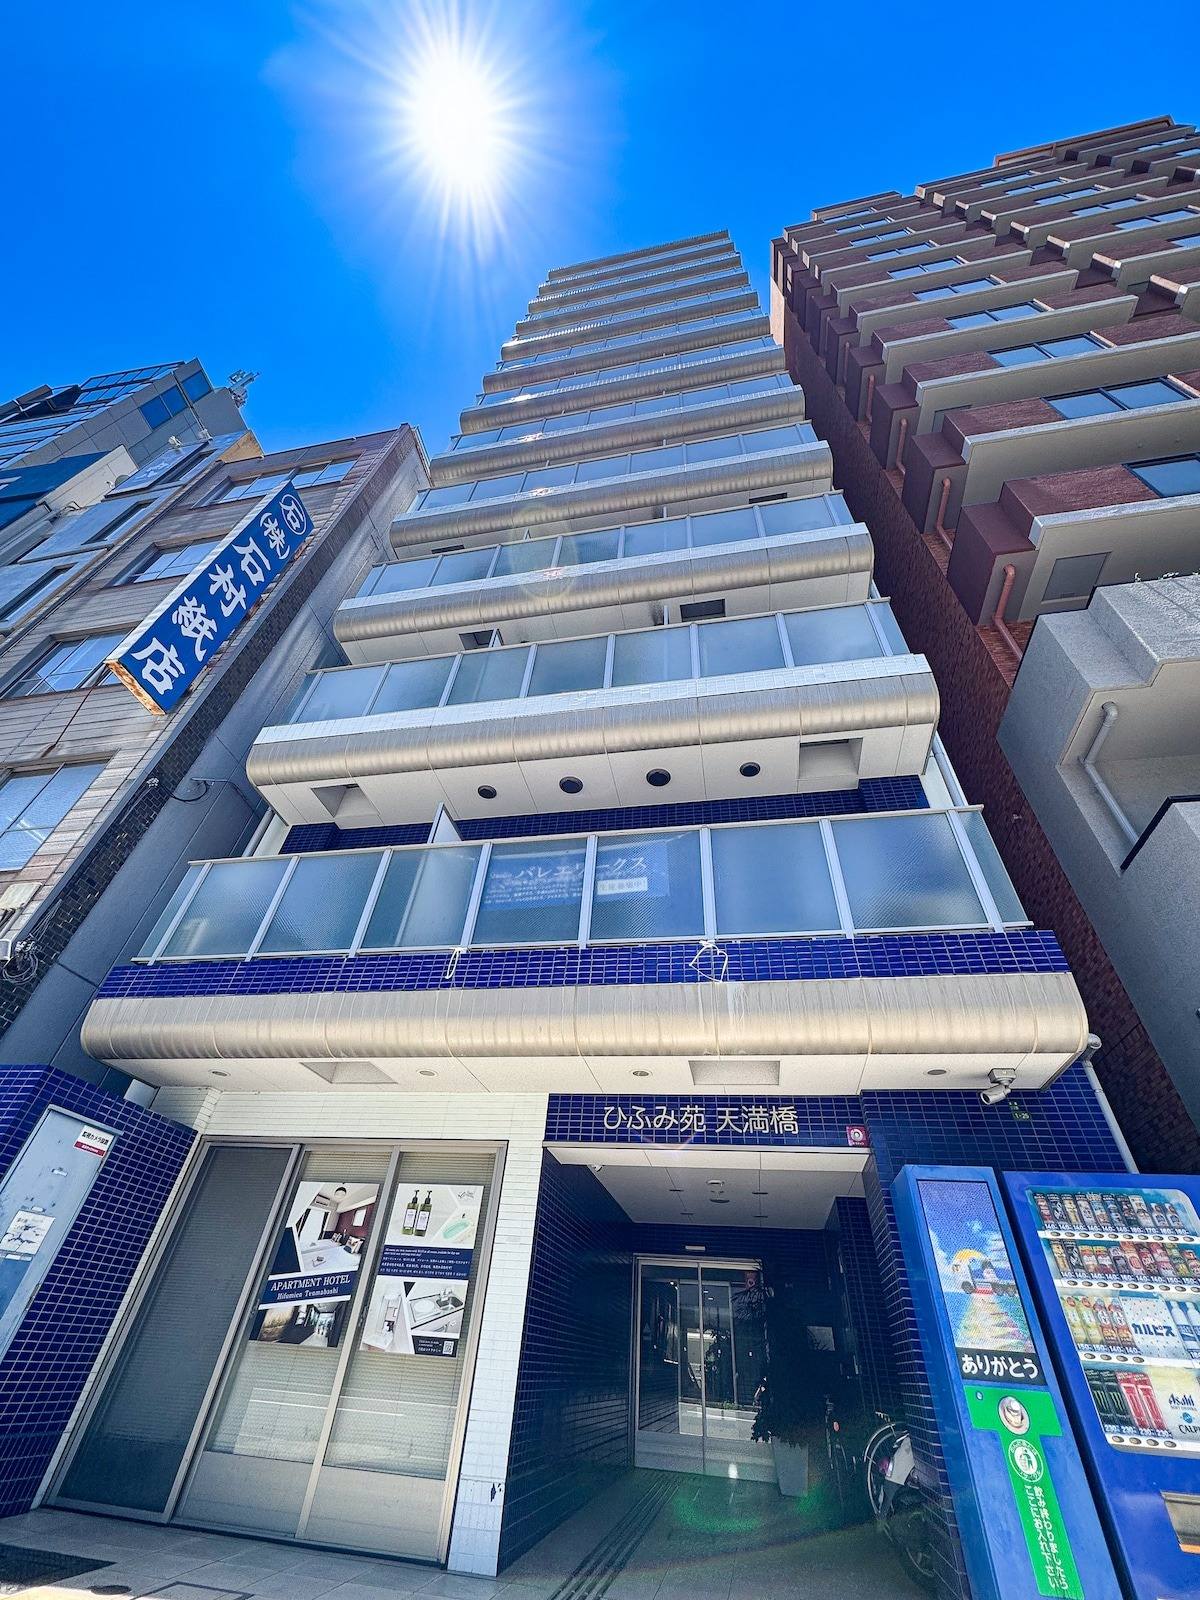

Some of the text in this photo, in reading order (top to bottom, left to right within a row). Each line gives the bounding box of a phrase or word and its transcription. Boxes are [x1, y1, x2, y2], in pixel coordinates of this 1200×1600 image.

[603, 1104, 799, 1134] ひふみ苑 天満橋
[271, 1275, 351, 1291] APARTMENT HOTEL
[1131, 1323, 1175, 1337] カルピス
[962, 1354, 1038, 1379] ありがとう
[1169, 1393, 1194, 1406] Asahi
[1024, 1485, 1059, 1589] ここにお入れ下さい
[1033, 1485, 1068, 1590] 飲み終わりましたら
